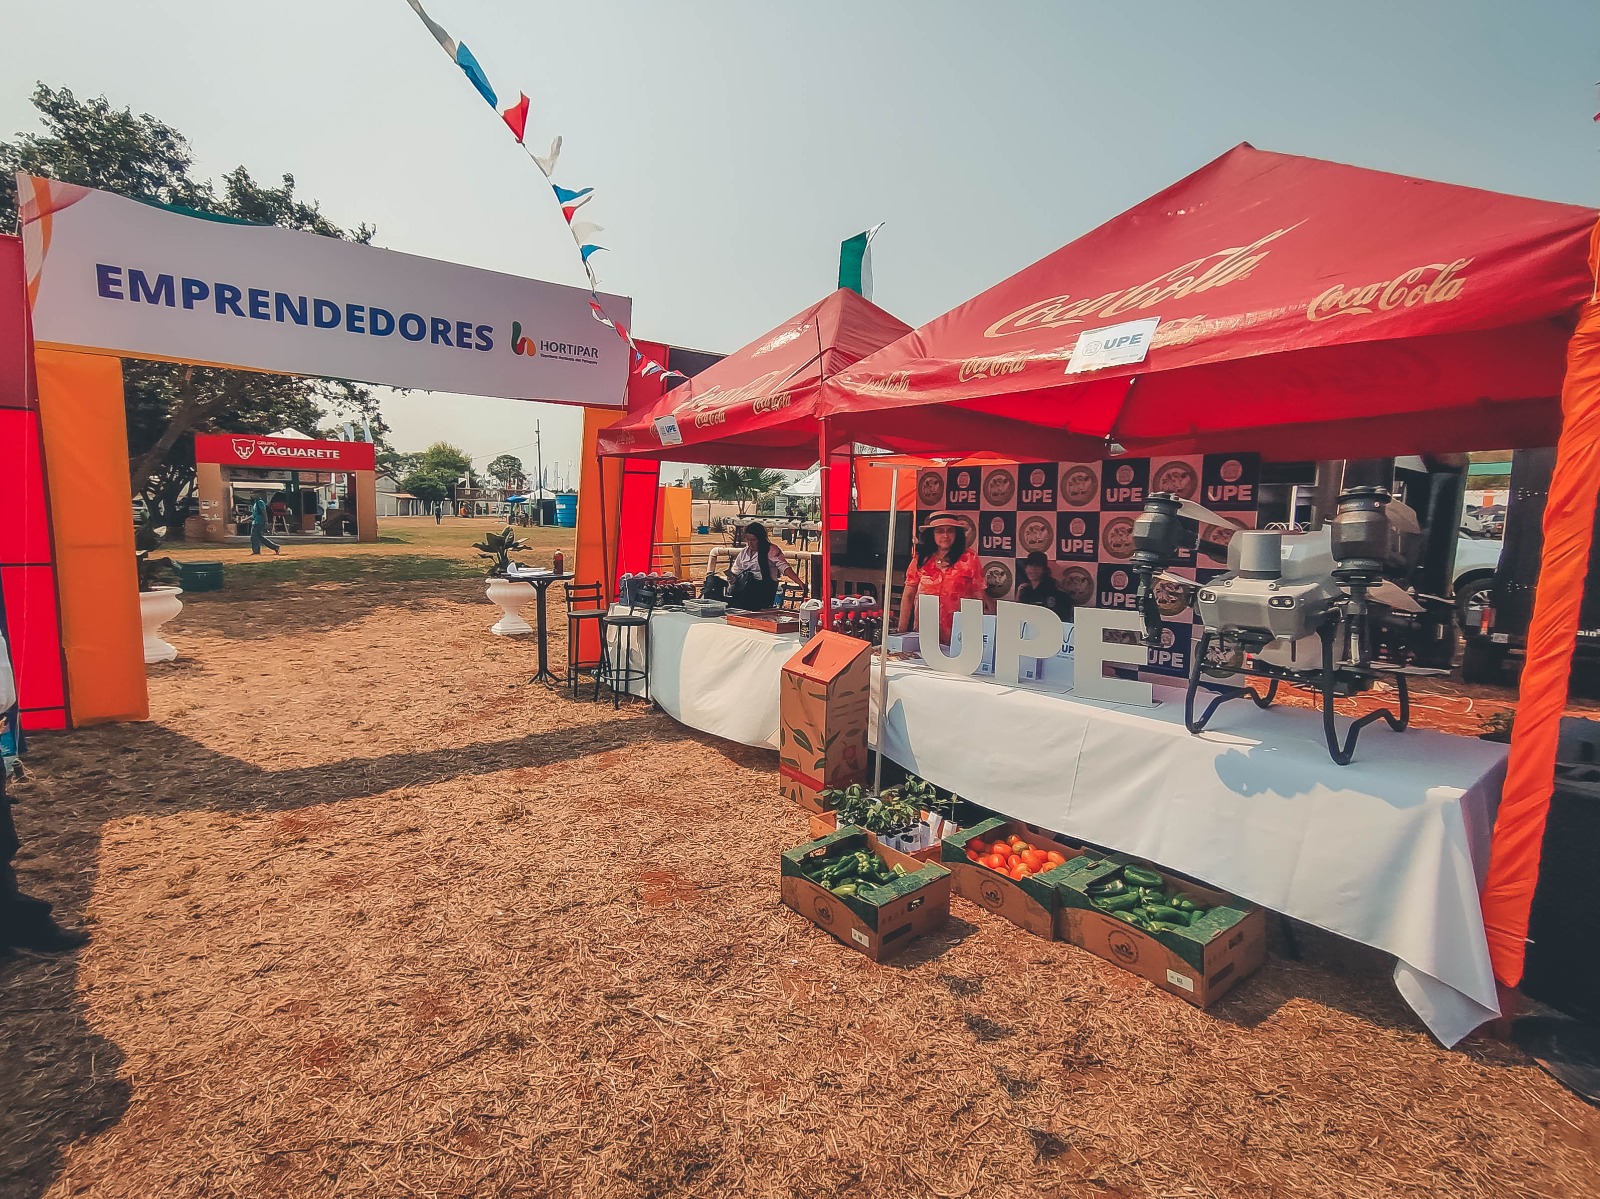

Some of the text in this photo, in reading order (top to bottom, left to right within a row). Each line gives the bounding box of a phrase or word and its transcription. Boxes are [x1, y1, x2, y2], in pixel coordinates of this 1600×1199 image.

[1306, 256, 1477, 322] Coca-Cola
[95, 262, 495, 353] EMPRENDEDORES
[540, 340, 599, 359] HORTIPAR
[1103, 333, 1143, 350] UPE
[664, 424, 677, 434] UPE
[258, 446, 340, 459] YAGUARETE
[950, 490, 976, 504] UPE
[1022, 489, 1053, 503] UPE
[1106, 487, 1143, 502] UPE
[1207, 484, 1252, 502] UPE
[983, 535, 1012, 550] UPE
[1061, 538, 1094, 554] UPE
[1101, 591, 1137, 609] UPE
[918, 593, 1153, 704] UPE
[1148, 648, 1184, 668] UPE
